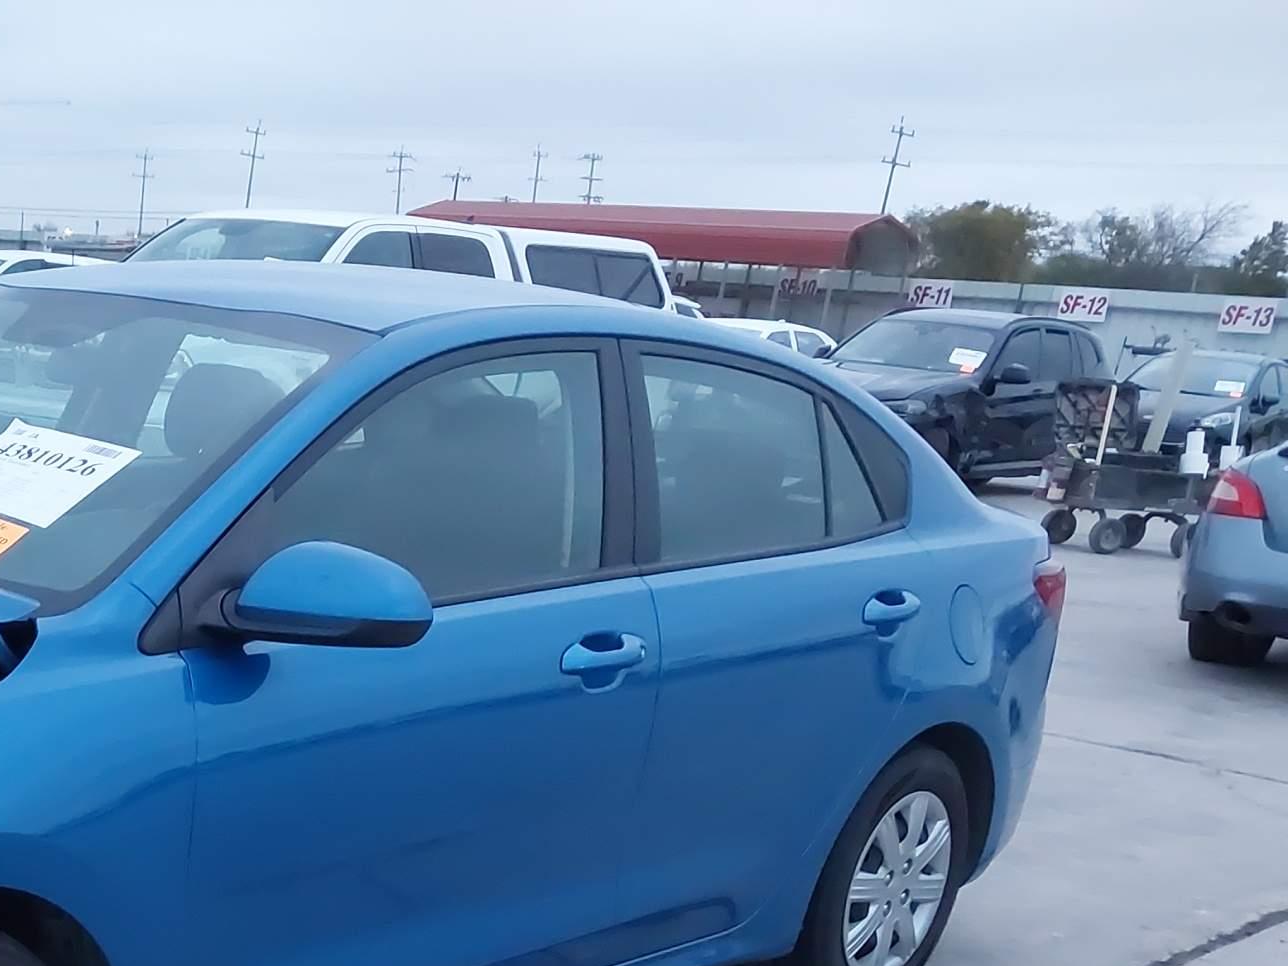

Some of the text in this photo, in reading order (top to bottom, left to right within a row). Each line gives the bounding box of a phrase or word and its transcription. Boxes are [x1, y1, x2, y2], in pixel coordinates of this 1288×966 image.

[910, 285, 952, 305] SF-11
[1059, 294, 1108, 316] SF-12
[1222, 304, 1275, 328] SF-13
